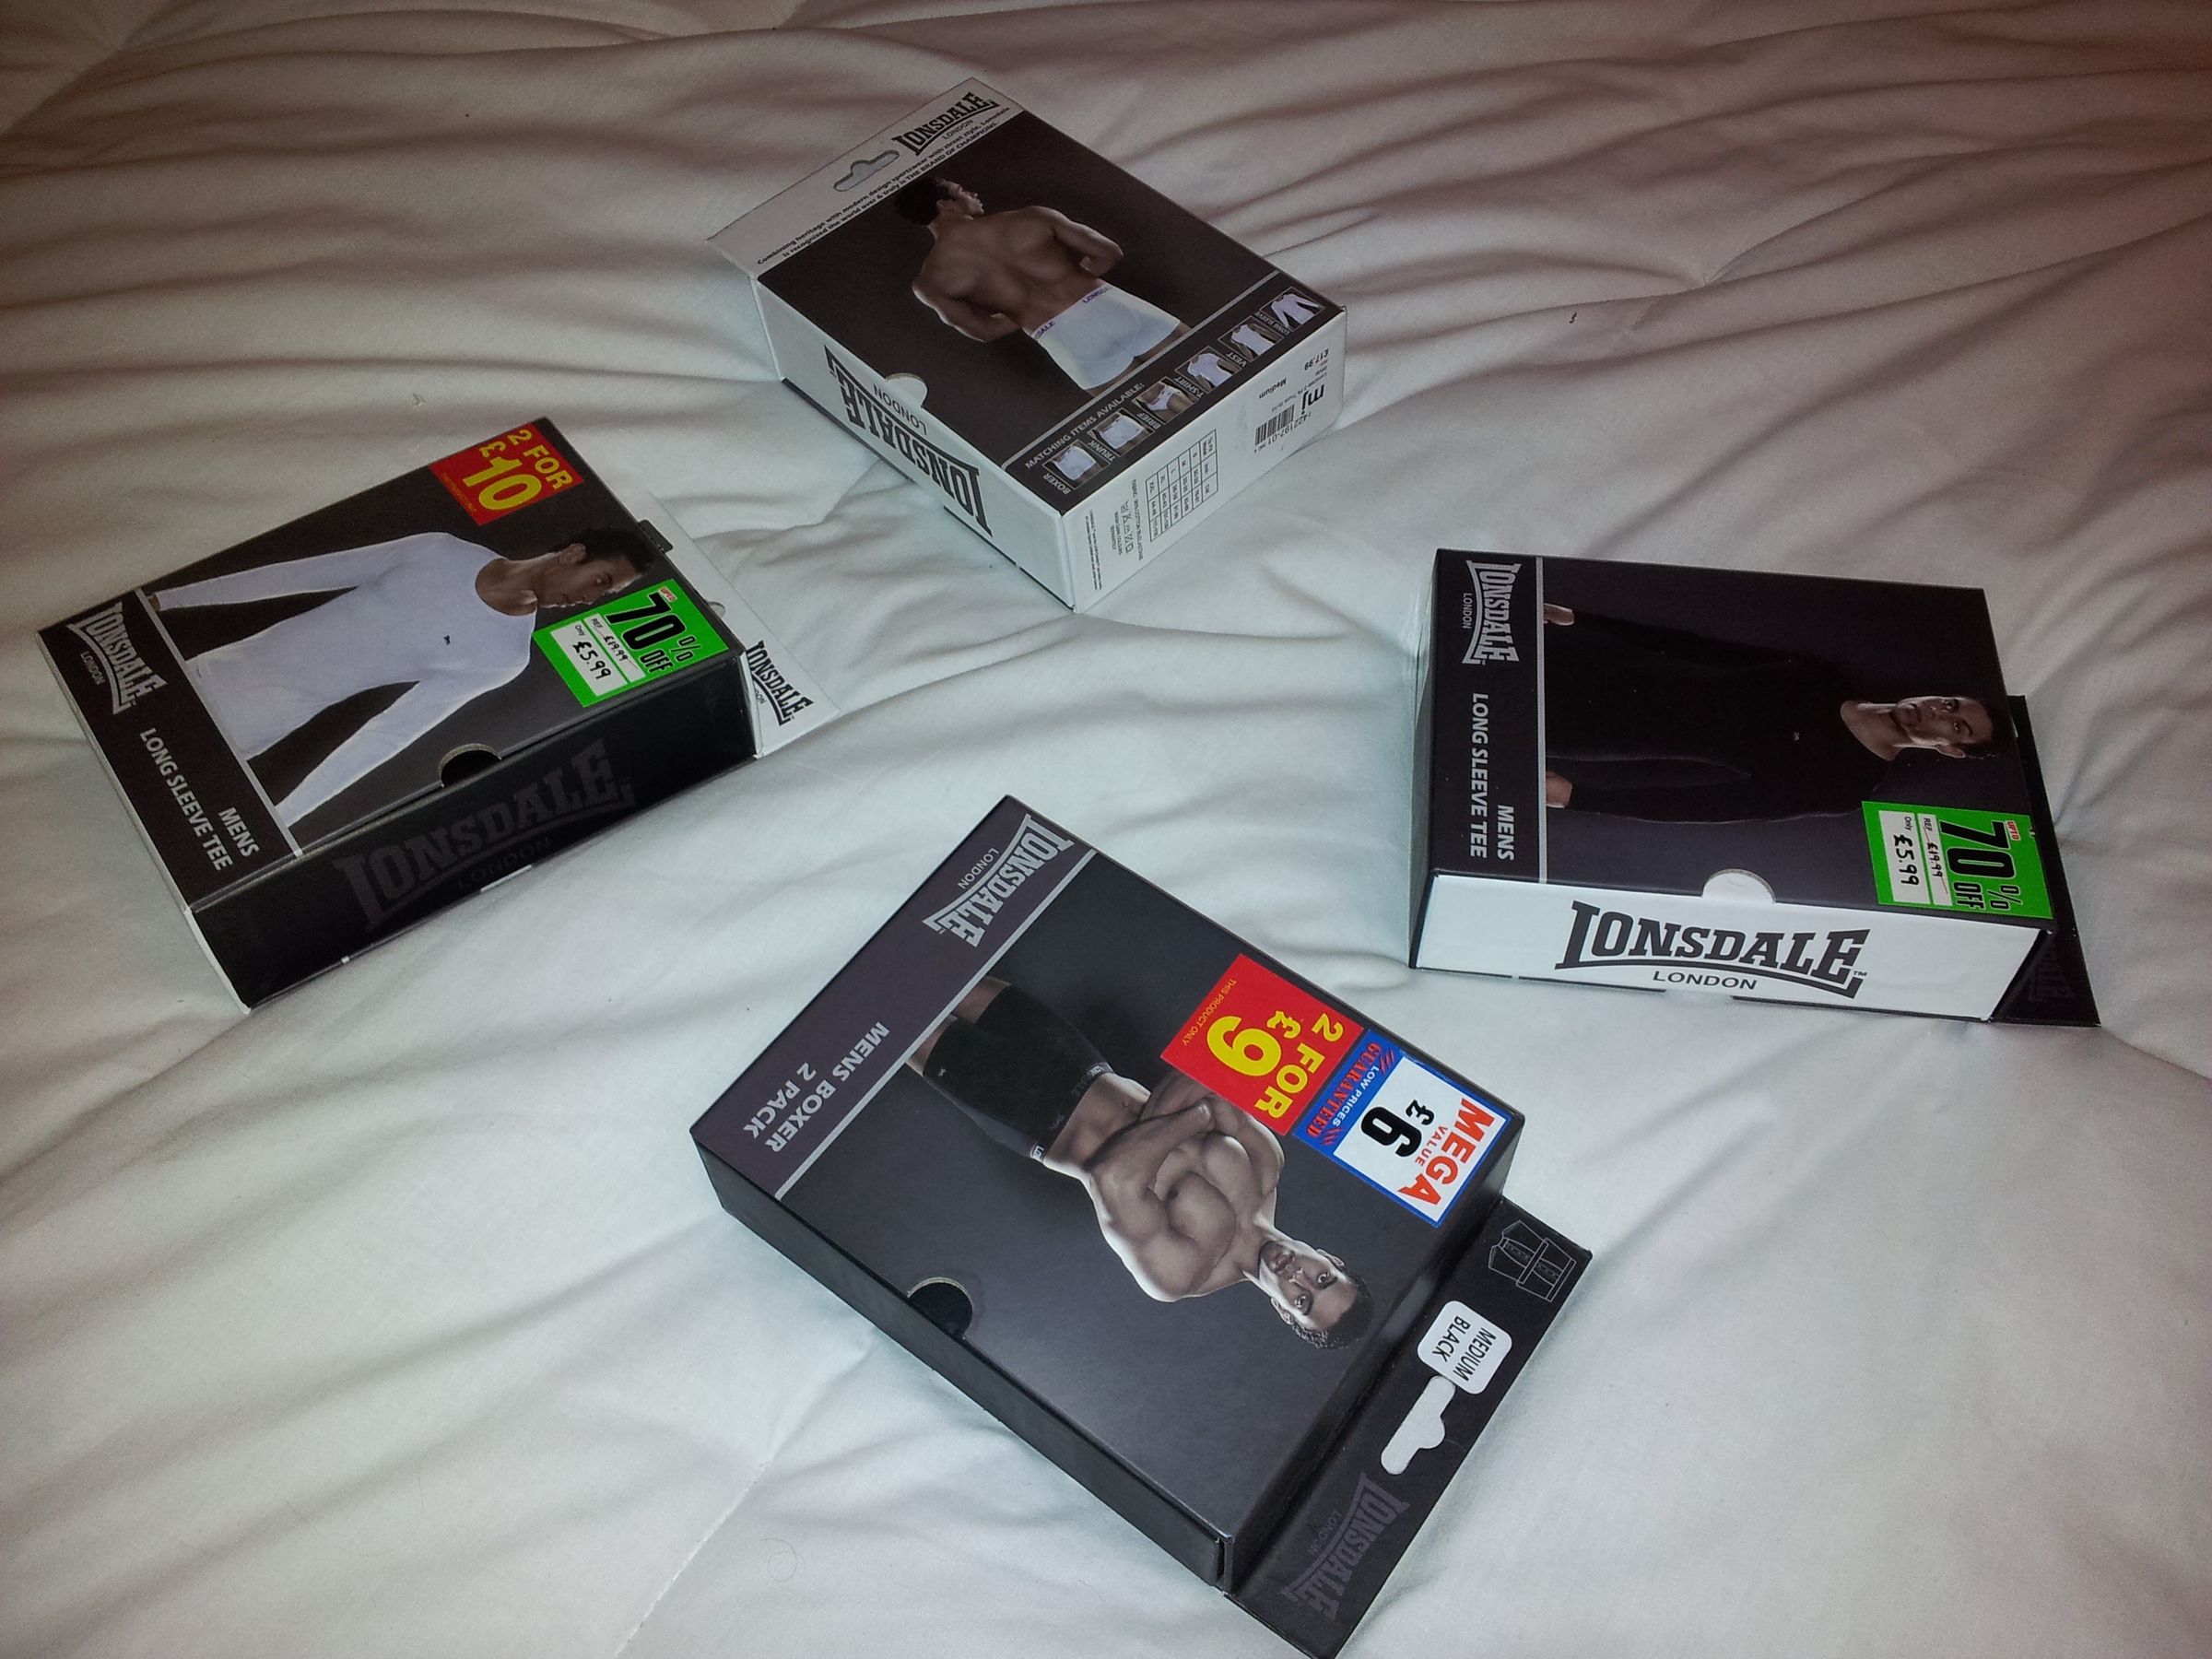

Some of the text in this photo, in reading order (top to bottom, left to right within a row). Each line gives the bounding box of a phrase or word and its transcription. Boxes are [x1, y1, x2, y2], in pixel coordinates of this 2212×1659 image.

[892, 92, 1000, 156] LONSDALE
[943, 120, 973, 140] LONDON
[758, 238, 796, 262] Combining
[795, 222, 825, 241] heritage
[826, 211, 842, 223] with
[842, 195, 868, 213] modern
[928, 147, 945, 159] with
[841, 208, 861, 222] world
[862, 198, 877, 209] over
[906, 170, 922, 182] THE
[921, 154, 947, 171] BRAND
[946, 148, 956, 157] OF
[1174, 376, 1205, 398] T-SHIRT
[1226, 351, 1248, 368] VEST
[1259, 378, 1287, 399] Medium
[1304, 348, 1329, 371] £17.99
[873, 383, 928, 435] LONDON
[1025, 382, 1145, 469] MATCHING ITEMS AVAILABLE:
[1136, 411, 1162, 429] BRIEF
[1301, 384, 1324, 415] mj
[508, 429, 572, 489] 2 FOR
[824, 344, 993, 537] LONSDALE
[1088, 440, 1116, 462] TRUNK
[463, 441, 542, 510] £10
[1042, 472, 1072, 495] BOXER
[1462, 593, 1473, 629] LONDON
[1462, 559, 1521, 665] LONSDALE
[66, 602, 168, 715] LONSDALE
[81, 652, 106, 686] LONDON
[572, 641, 611, 679] £5.99
[603, 635, 628, 661] £19.99
[640, 650, 674, 673] OFF
[140, 727, 234, 871] LONG SLEEVE TEE
[1470, 693, 1488, 859] LONG SLEEVE TEE
[218, 806, 260, 857] MENS
[334, 738, 637, 931] LONSDALE
[1497, 804, 1514, 861] MENS
[1893, 817, 1919, 886] Only £5.99
[1923, 818, 1943, 877] REF £19.99
[922, 813, 1076, 947] LONSDALE
[958, 848, 1000, 889] LONDON
[1954, 882, 1984, 910] OFF
[1554, 900, 1871, 999] LONSDALE
[1653, 971, 1758, 990] LONDON
[1182, 979, 1237, 1046] THIS PRODUCT ONLY
[765, 1021, 890, 1153] MENS BOXER
[1254, 1013, 1344, 1119] 2 FOR
[1307, 1042, 1382, 1137] GUARANTEED
[743, 1062, 818, 1140] 2 PACK
[1333, 1065, 1380, 1127] LOW PRICES
[1397, 1098, 1495, 1205] MEGA
[1415, 1125, 1448, 1167] VALUE
[1431, 1315, 1471, 1362] BLACK
[1453, 1326, 1497, 1382] MEDIUM
[1280, 1471, 1410, 1621] LONSDALE
[1310, 1511, 1342, 1555] LONDON
